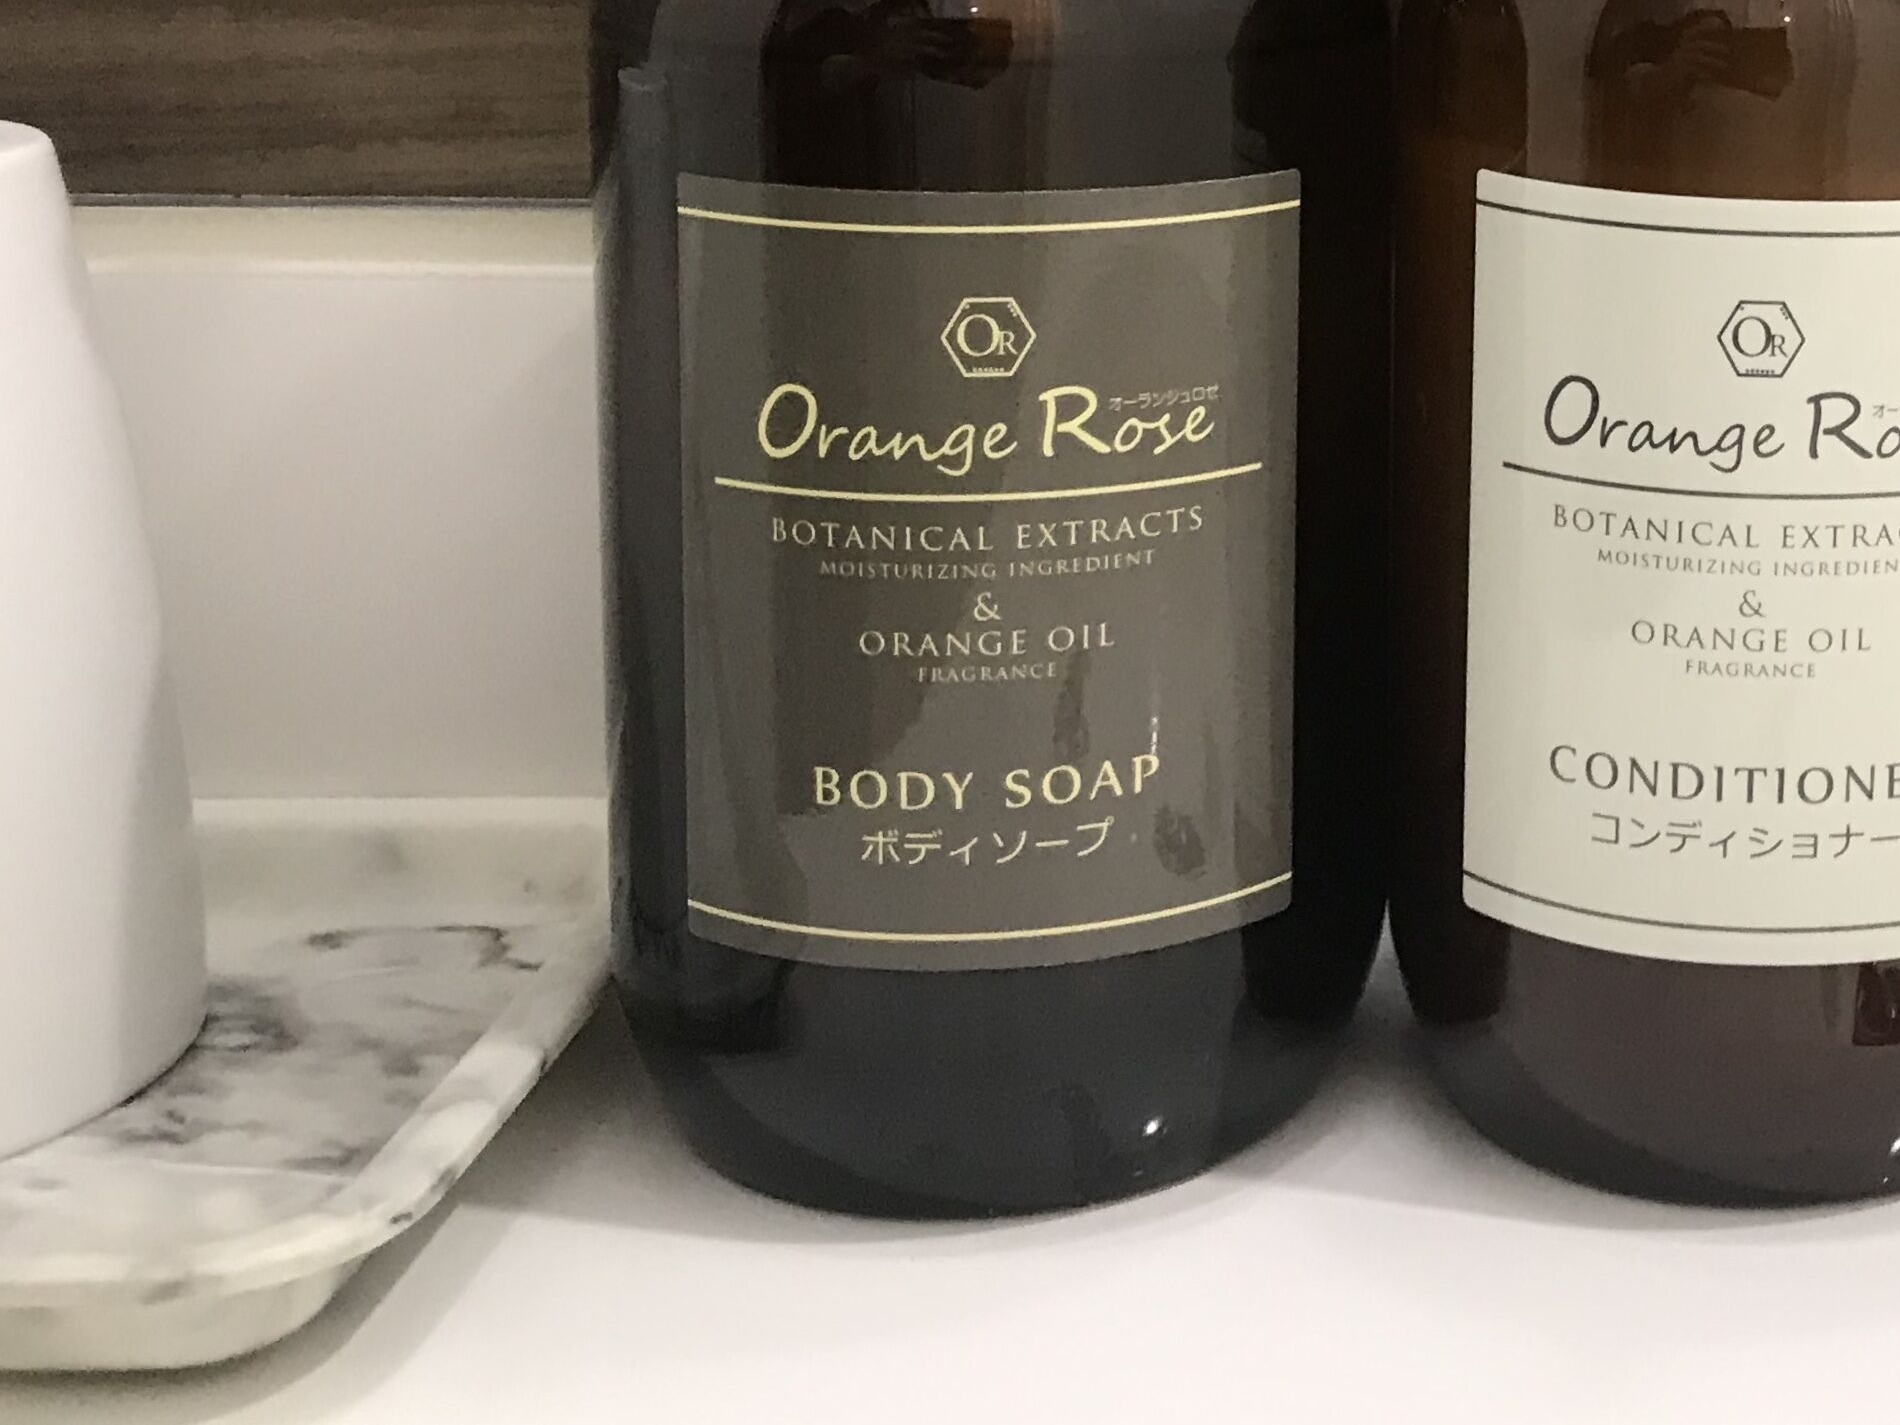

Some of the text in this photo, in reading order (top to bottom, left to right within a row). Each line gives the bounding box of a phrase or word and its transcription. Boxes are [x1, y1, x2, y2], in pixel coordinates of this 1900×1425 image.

[756, 381, 1213, 475] Orange Rose
[1542, 374, 1784, 472] Orange
[772, 505, 1203, 551] BOTANICAL EXTRACTS
[1553, 503, 1758, 549] BOTANICAL
[819, 548, 1154, 578] MOISTURIZING INGREDIENT
[1596, 548, 1761, 574] MOISTURIZING
[973, 593, 999, 620] &
[1737, 589, 1765, 617] &
[858, 622, 1113, 656] ORANGE OIL
[1630, 620, 1870, 651] ORANGE OIL
[917, 661, 1057, 681] FRAGRANCE
[1684, 659, 1816, 677] FRAGRANCE
[812, 753, 1160, 809] BODY SOAP
[860, 814, 1113, 865] ボディソープ
[1590, 811, 1900, 860] コンディショナー
